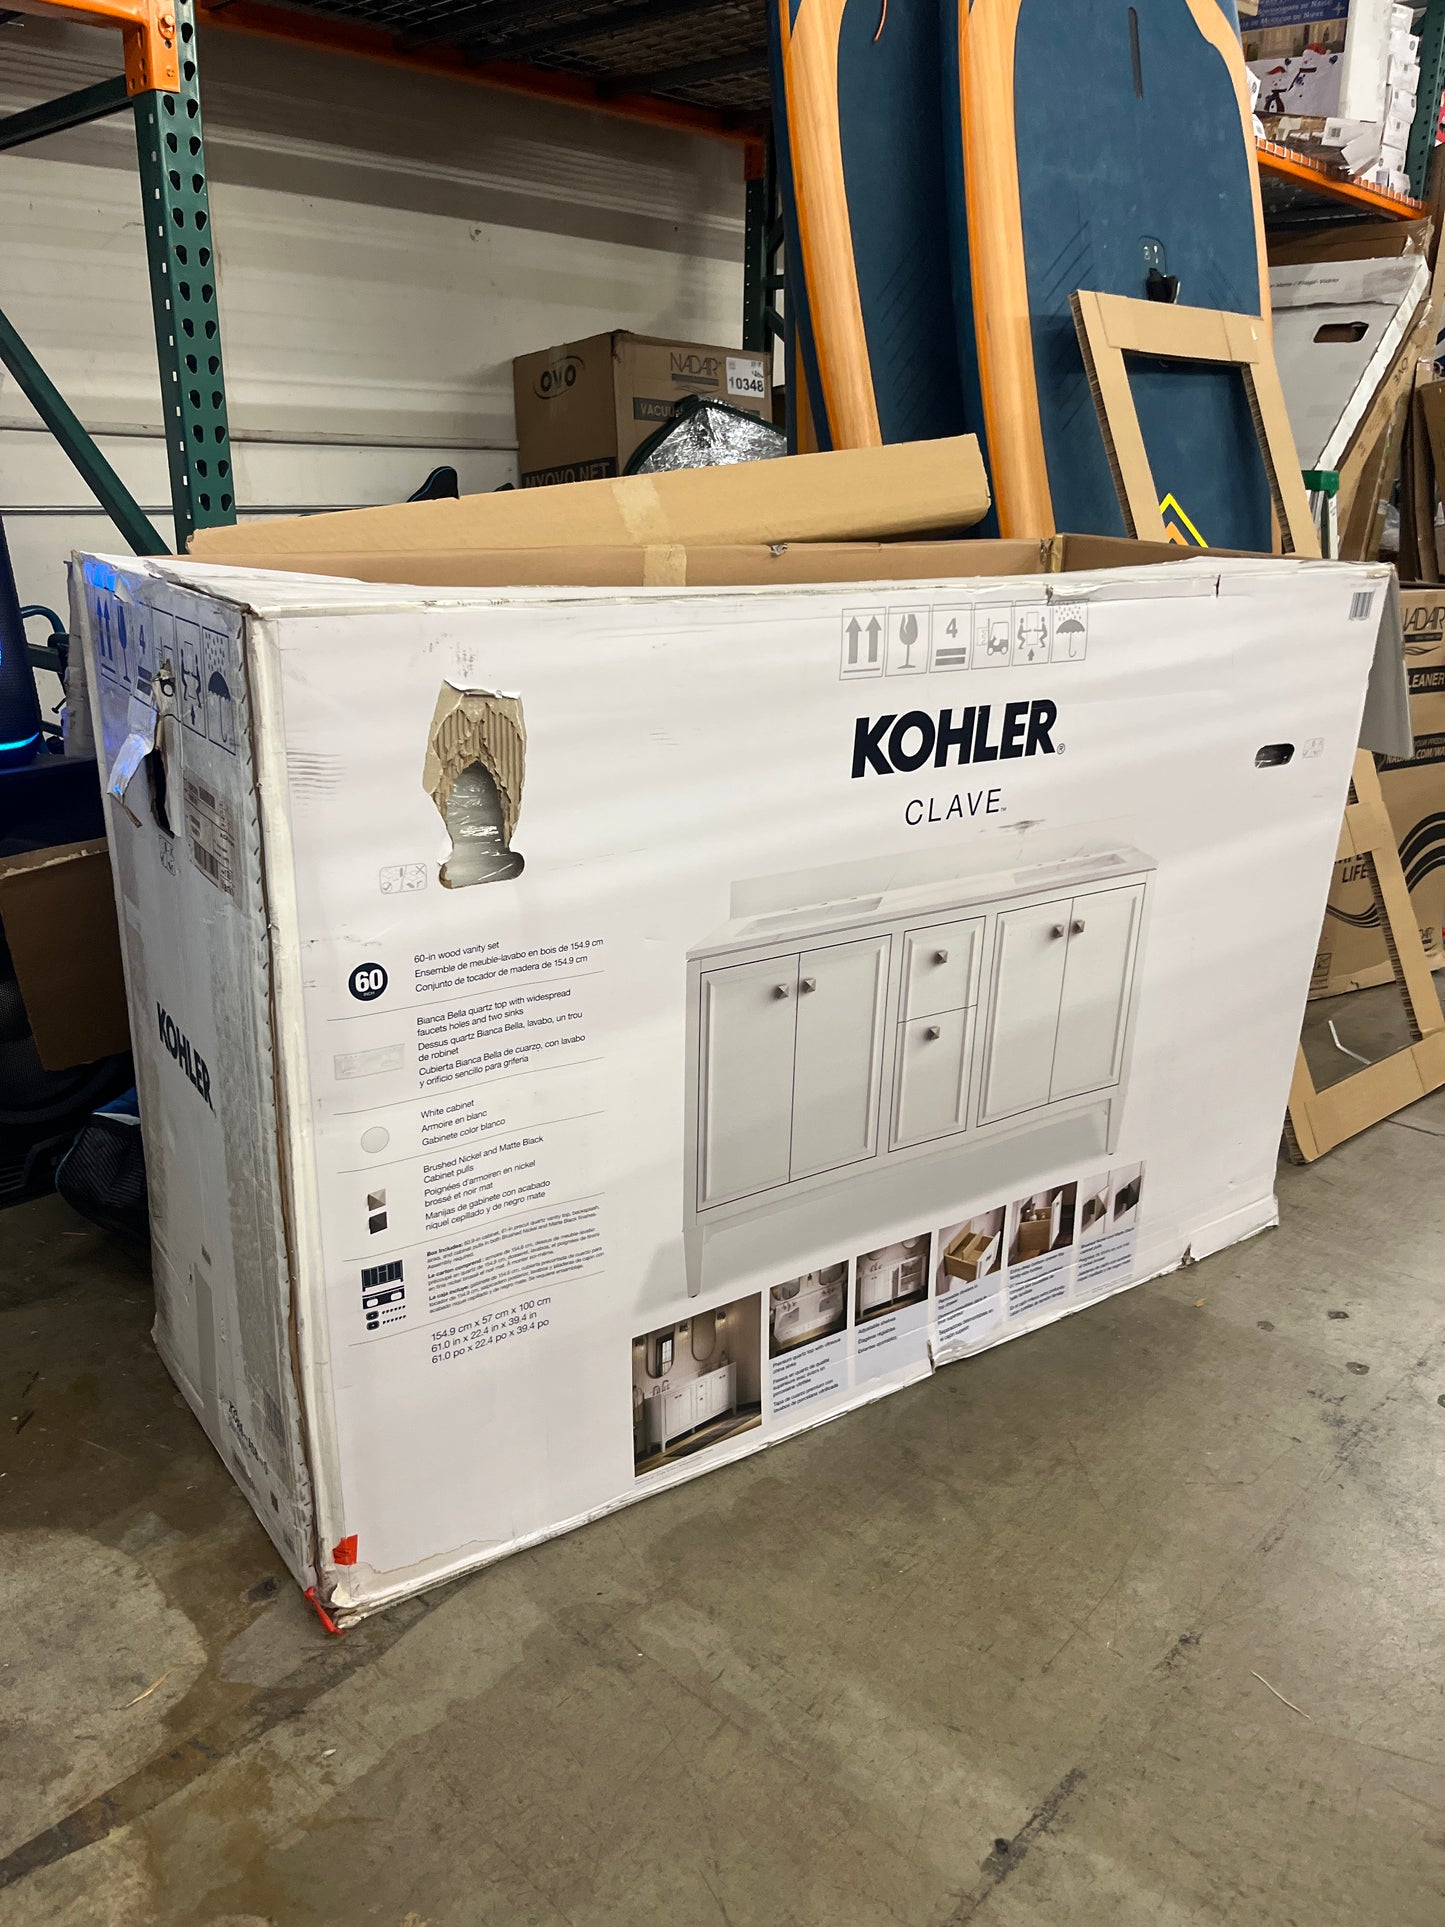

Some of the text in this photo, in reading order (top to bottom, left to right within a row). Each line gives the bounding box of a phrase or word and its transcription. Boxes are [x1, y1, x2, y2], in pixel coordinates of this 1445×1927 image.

[541, 365, 577, 392] OVO
[729, 376, 764, 393] 10348
[851, 699, 1058, 779] KOHLER
[905, 788, 1002, 826] CLAVE
[1342, 863, 1368, 884] LIFE
[414, 942, 499, 964] 60-in wood vanity set
[415, 965, 456, 978] Ensemble
[457, 962, 468, 971] de
[469, 952, 526, 968] meuble-lavabo
[540, 948, 557, 956] bois
[558, 945, 569, 953] de
[570, 940, 590, 950] 154.9
[355, 969, 384, 992] 60
[415, 980, 453, 993] Conjunto
[454, 977, 465, 986] de
[466, 971, 496, 983] tocador
[510, 964, 540, 974] madera
[541, 961, 552, 969] de
[554, 957, 574, 967] 154.9
[575, 956, 588, 964] cm
[417, 1015, 446, 1026] Bianca
[447, 1010, 466, 1020] Bella
[468, 1004, 493, 1016] quartz
[509, 997, 525, 1006] with
[526, 989, 571, 1003] widespread
[417, 1009, 524, 1036] faucets holes and two sinks
[418, 1040, 449, 1051] Dessus
[450, 1033, 475, 1045] quartz
[477, 1027, 503, 1038] Bianca
[527, 1018, 554, 1027] lavabo,
[157, 1001, 214, 1113] KOHLER
[418, 1047, 459, 1062] de robinet
[419, 1064, 454, 1076] Cubierta
[455, 1057, 482, 1068] Bianca
[483, 1051, 502, 1061] Bella
[515, 1044, 543, 1054] cuarzo,
[544, 1040, 560, 1048] con
[561, 1036, 586, 1045] lavabo
[426, 1075, 453, 1086] orificio
[455, 1067, 483, 1079] sencillo
[484, 1062, 502, 1073] para
[420, 1100, 474, 1119] White cabinet
[421, 1111, 487, 1133] Armoire en blanc
[422, 1119, 506, 1146] Gabinete color blanco
[423, 1136, 544, 1173] Brushed Nickel and Matte Black
[514, 1160, 536, 1171] nickel
[423, 1165, 474, 1184] Cabinet pulls
[424, 1182, 493, 1208] brossé et noir mat
[425, 1181, 551, 1220] Manijas de gabinete con acabado
[451, 1209, 485, 1224] cepillado
[504, 1197, 525, 1207] negro
[527, 1192, 546, 1201] mate
[431, 1340, 451, 1353] 61.0
[452, 1338, 461, 1346] in
[470, 1327, 489, 1340] 22.4
[508, 1314, 527, 1326] 39.4
[529, 1312, 537, 1320] in
[432, 1328, 456, 1341] 154.9
[458, 1323, 472, 1333] cm
[482, 1314, 493, 1325] 57
[495, 1310, 509, 1320] cm
[519, 1300, 535, 1312] 100
[536, 1298, 551, 1306] cm
[432, 1351, 451, 1364] 61.0
[453, 1348, 466, 1359] po
[475, 1336, 493, 1349] 22.4
[495, 1333, 507, 1344] po
[516, 1322, 535, 1335] 39.4
[537, 1320, 550, 1330] po
